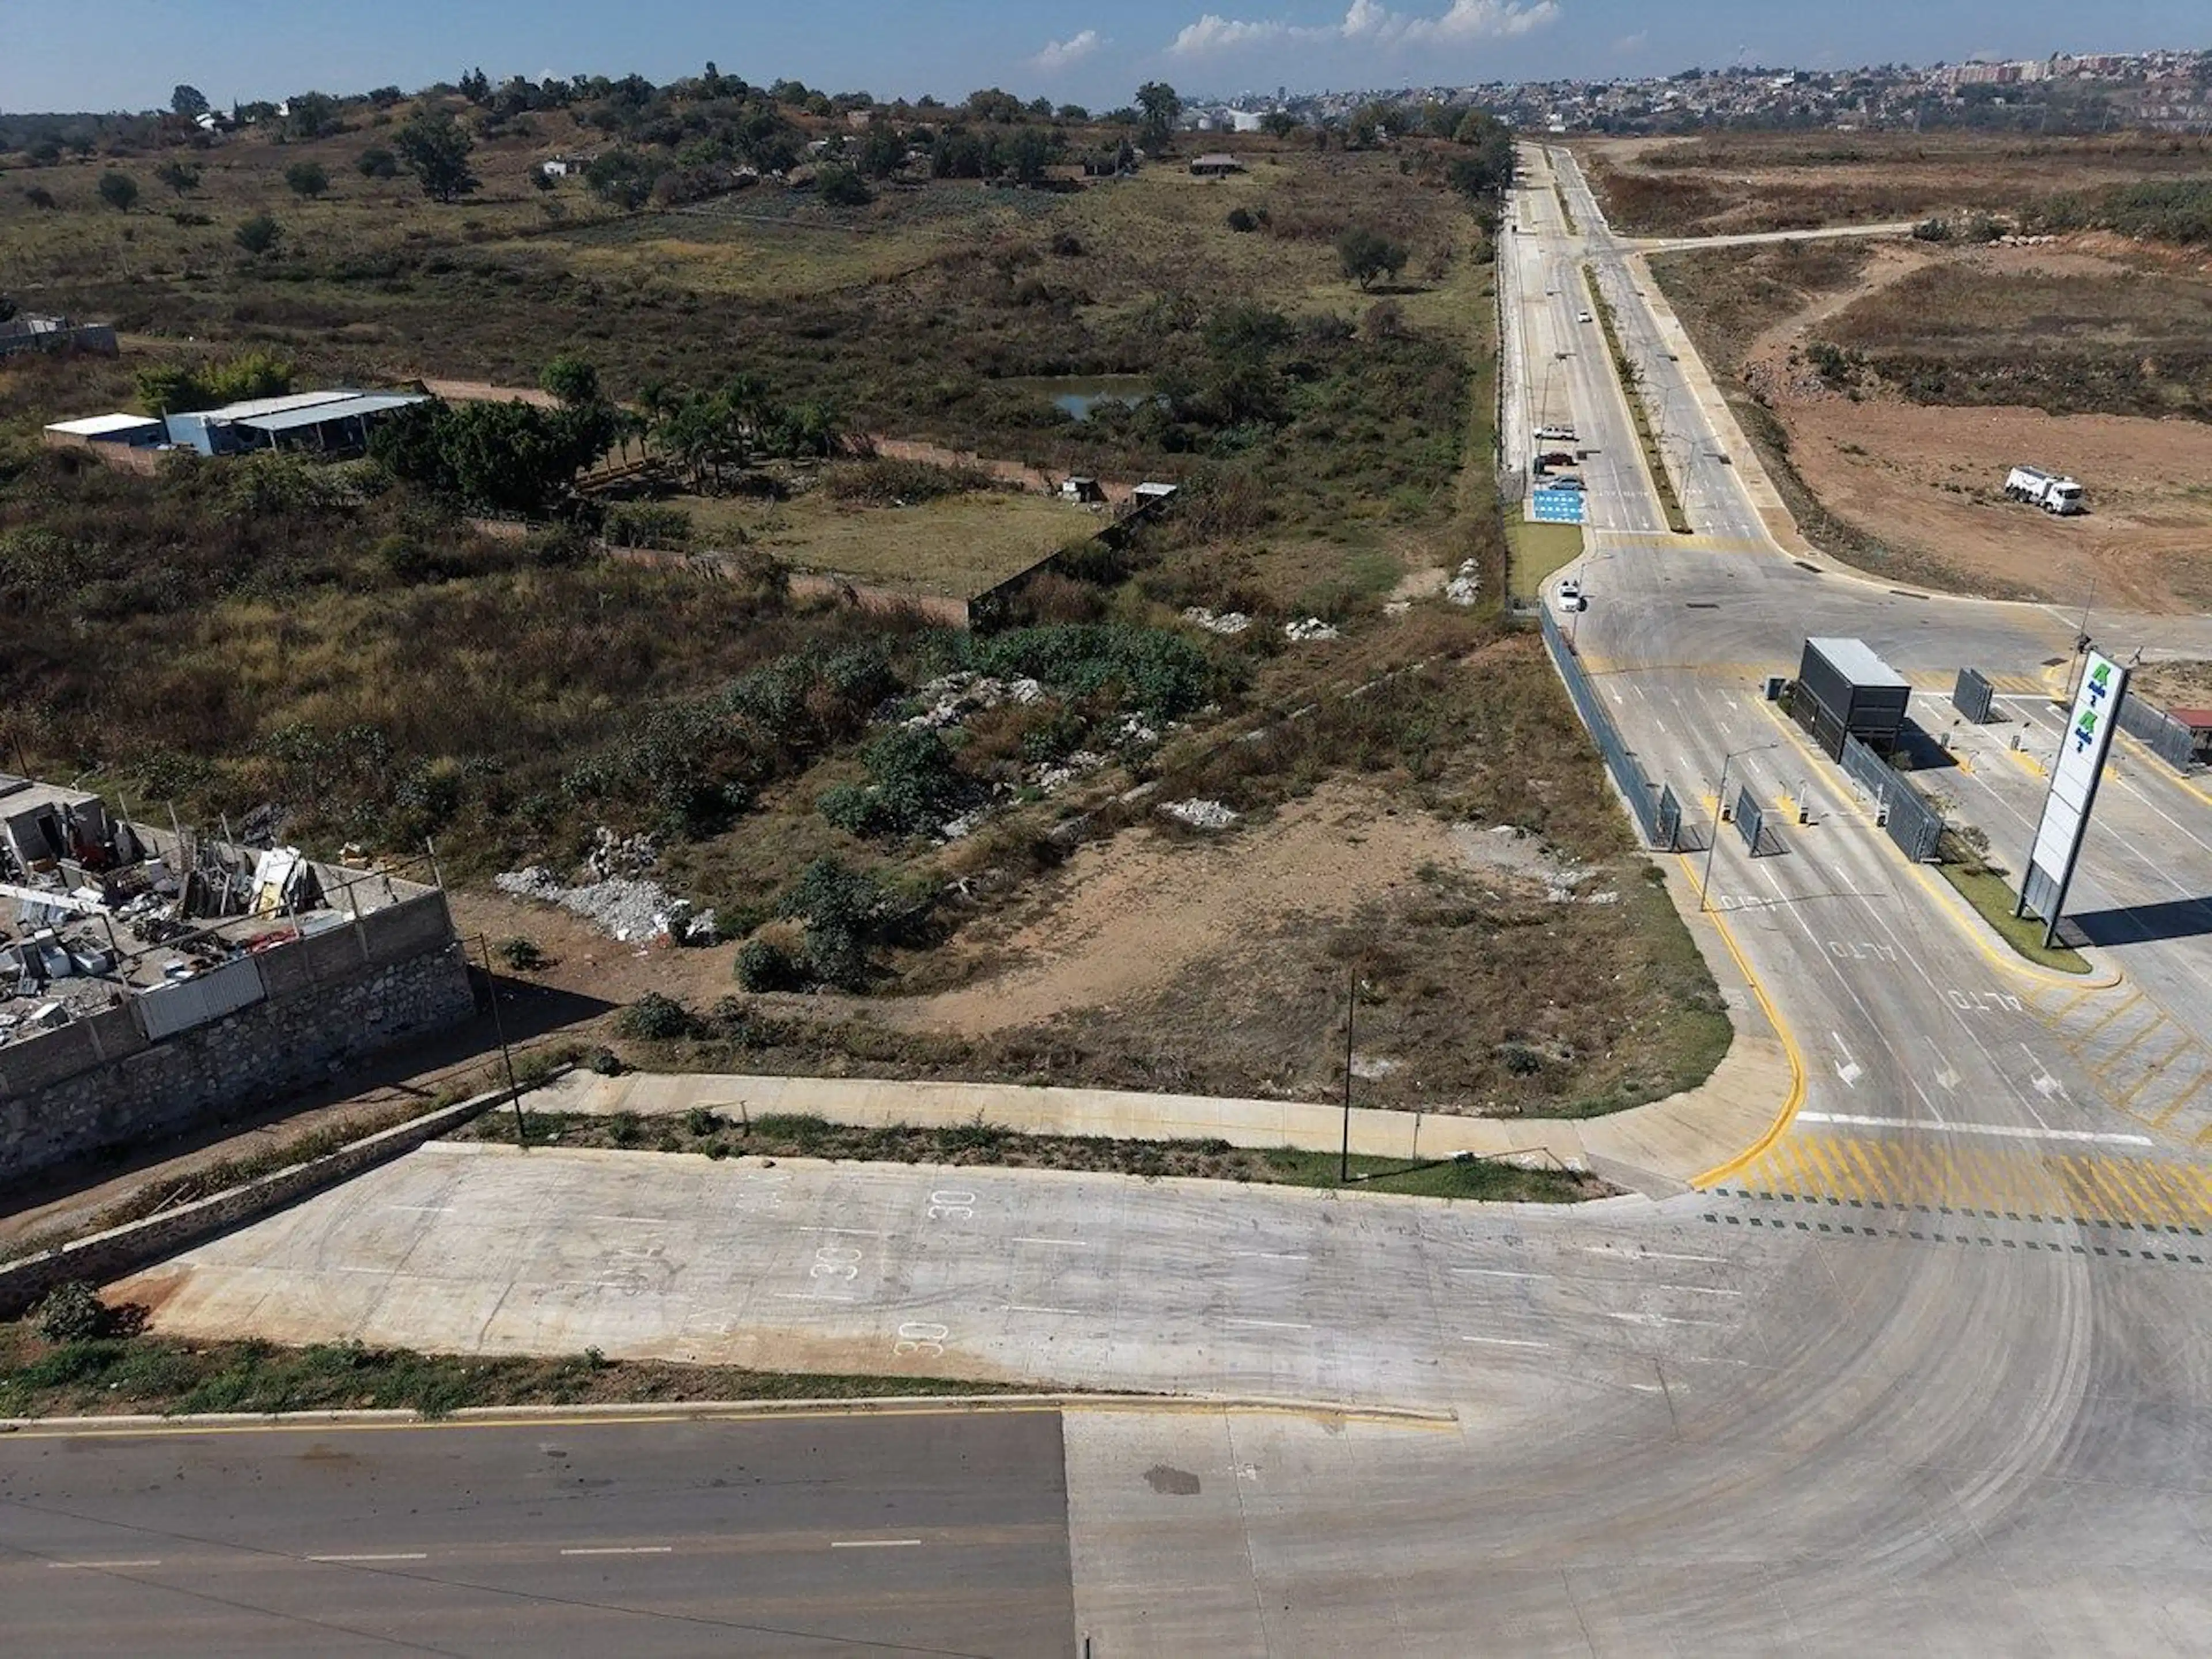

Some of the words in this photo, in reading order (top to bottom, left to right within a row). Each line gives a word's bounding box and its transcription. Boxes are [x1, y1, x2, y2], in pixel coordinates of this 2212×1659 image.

[1948, 990, 2023, 1012] ALTO
[929, 1191, 976, 1219] 30
[810, 1248, 862, 1280] 30
[893, 1323, 948, 1358] 30
